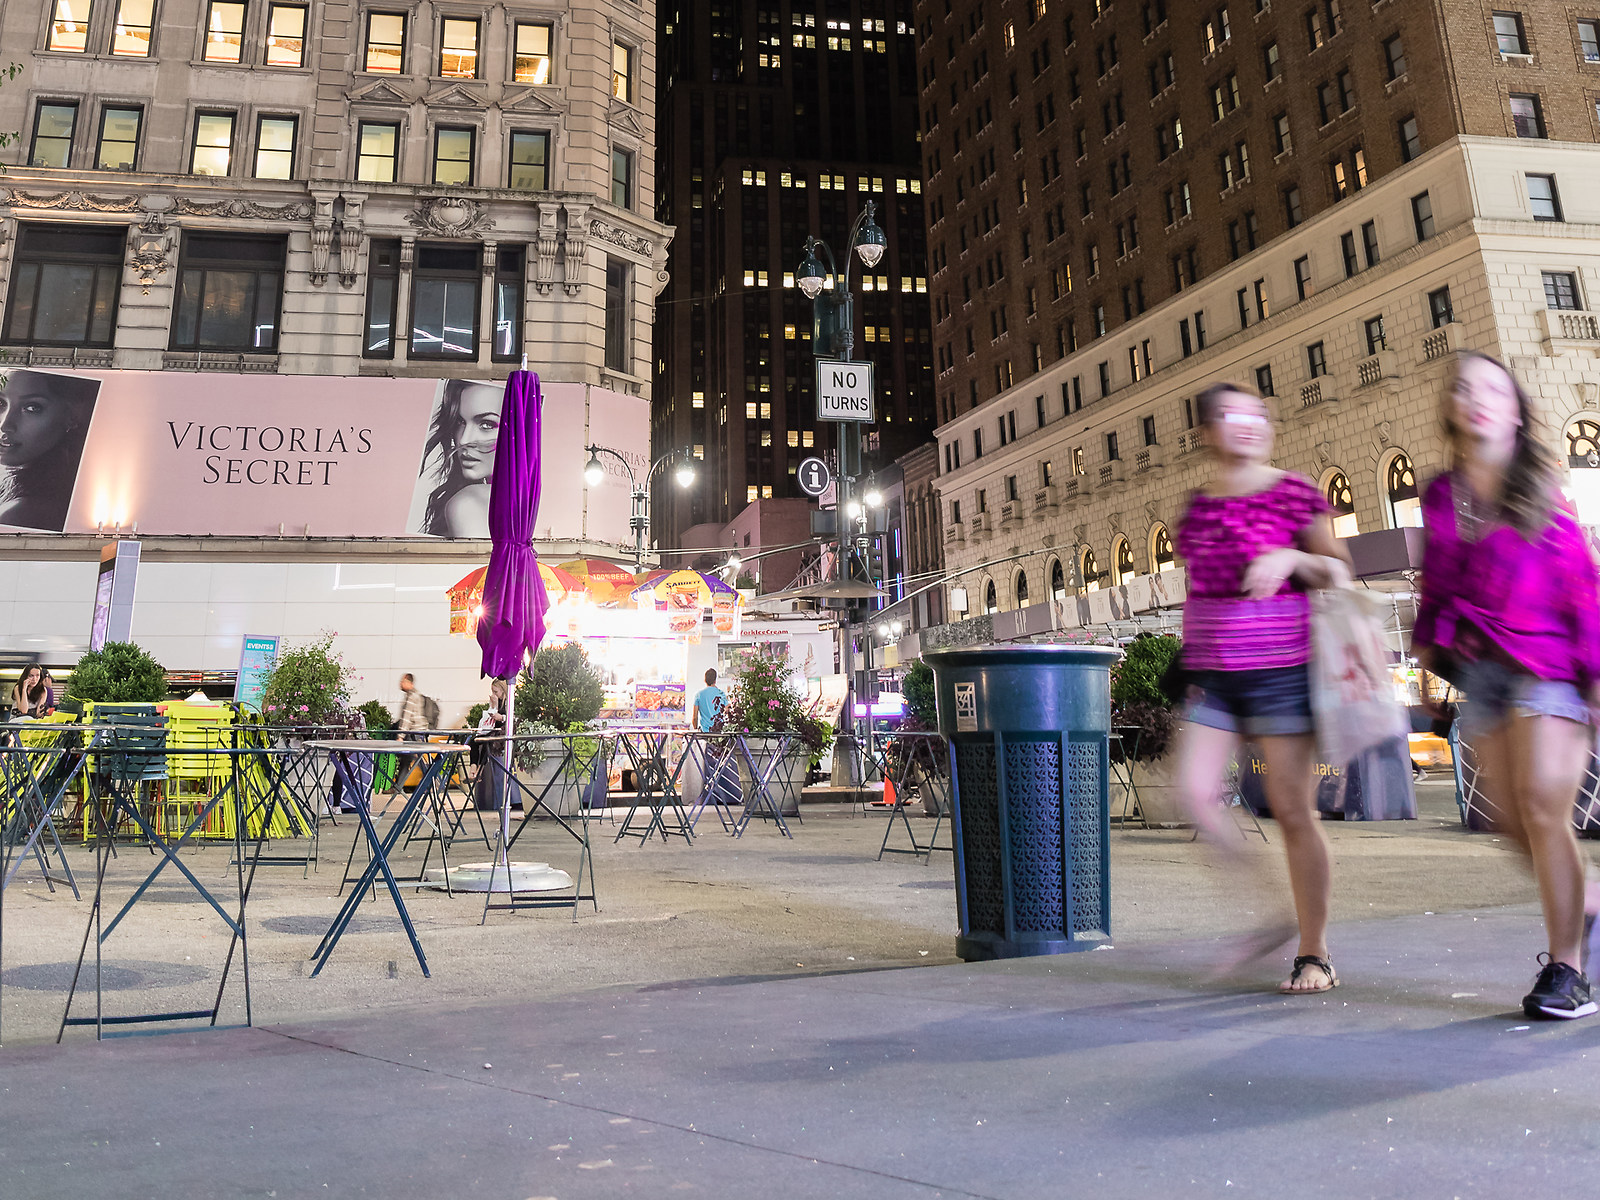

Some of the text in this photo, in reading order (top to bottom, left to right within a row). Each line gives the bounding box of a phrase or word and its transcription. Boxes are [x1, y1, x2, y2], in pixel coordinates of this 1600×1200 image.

[832, 371, 857, 389] NO
[823, 395, 868, 411] TURNS
[166, 421, 373, 454] VICTORIA'S
[203, 455, 338, 486] SECRET
[1014, 610, 1027, 635] GAP
